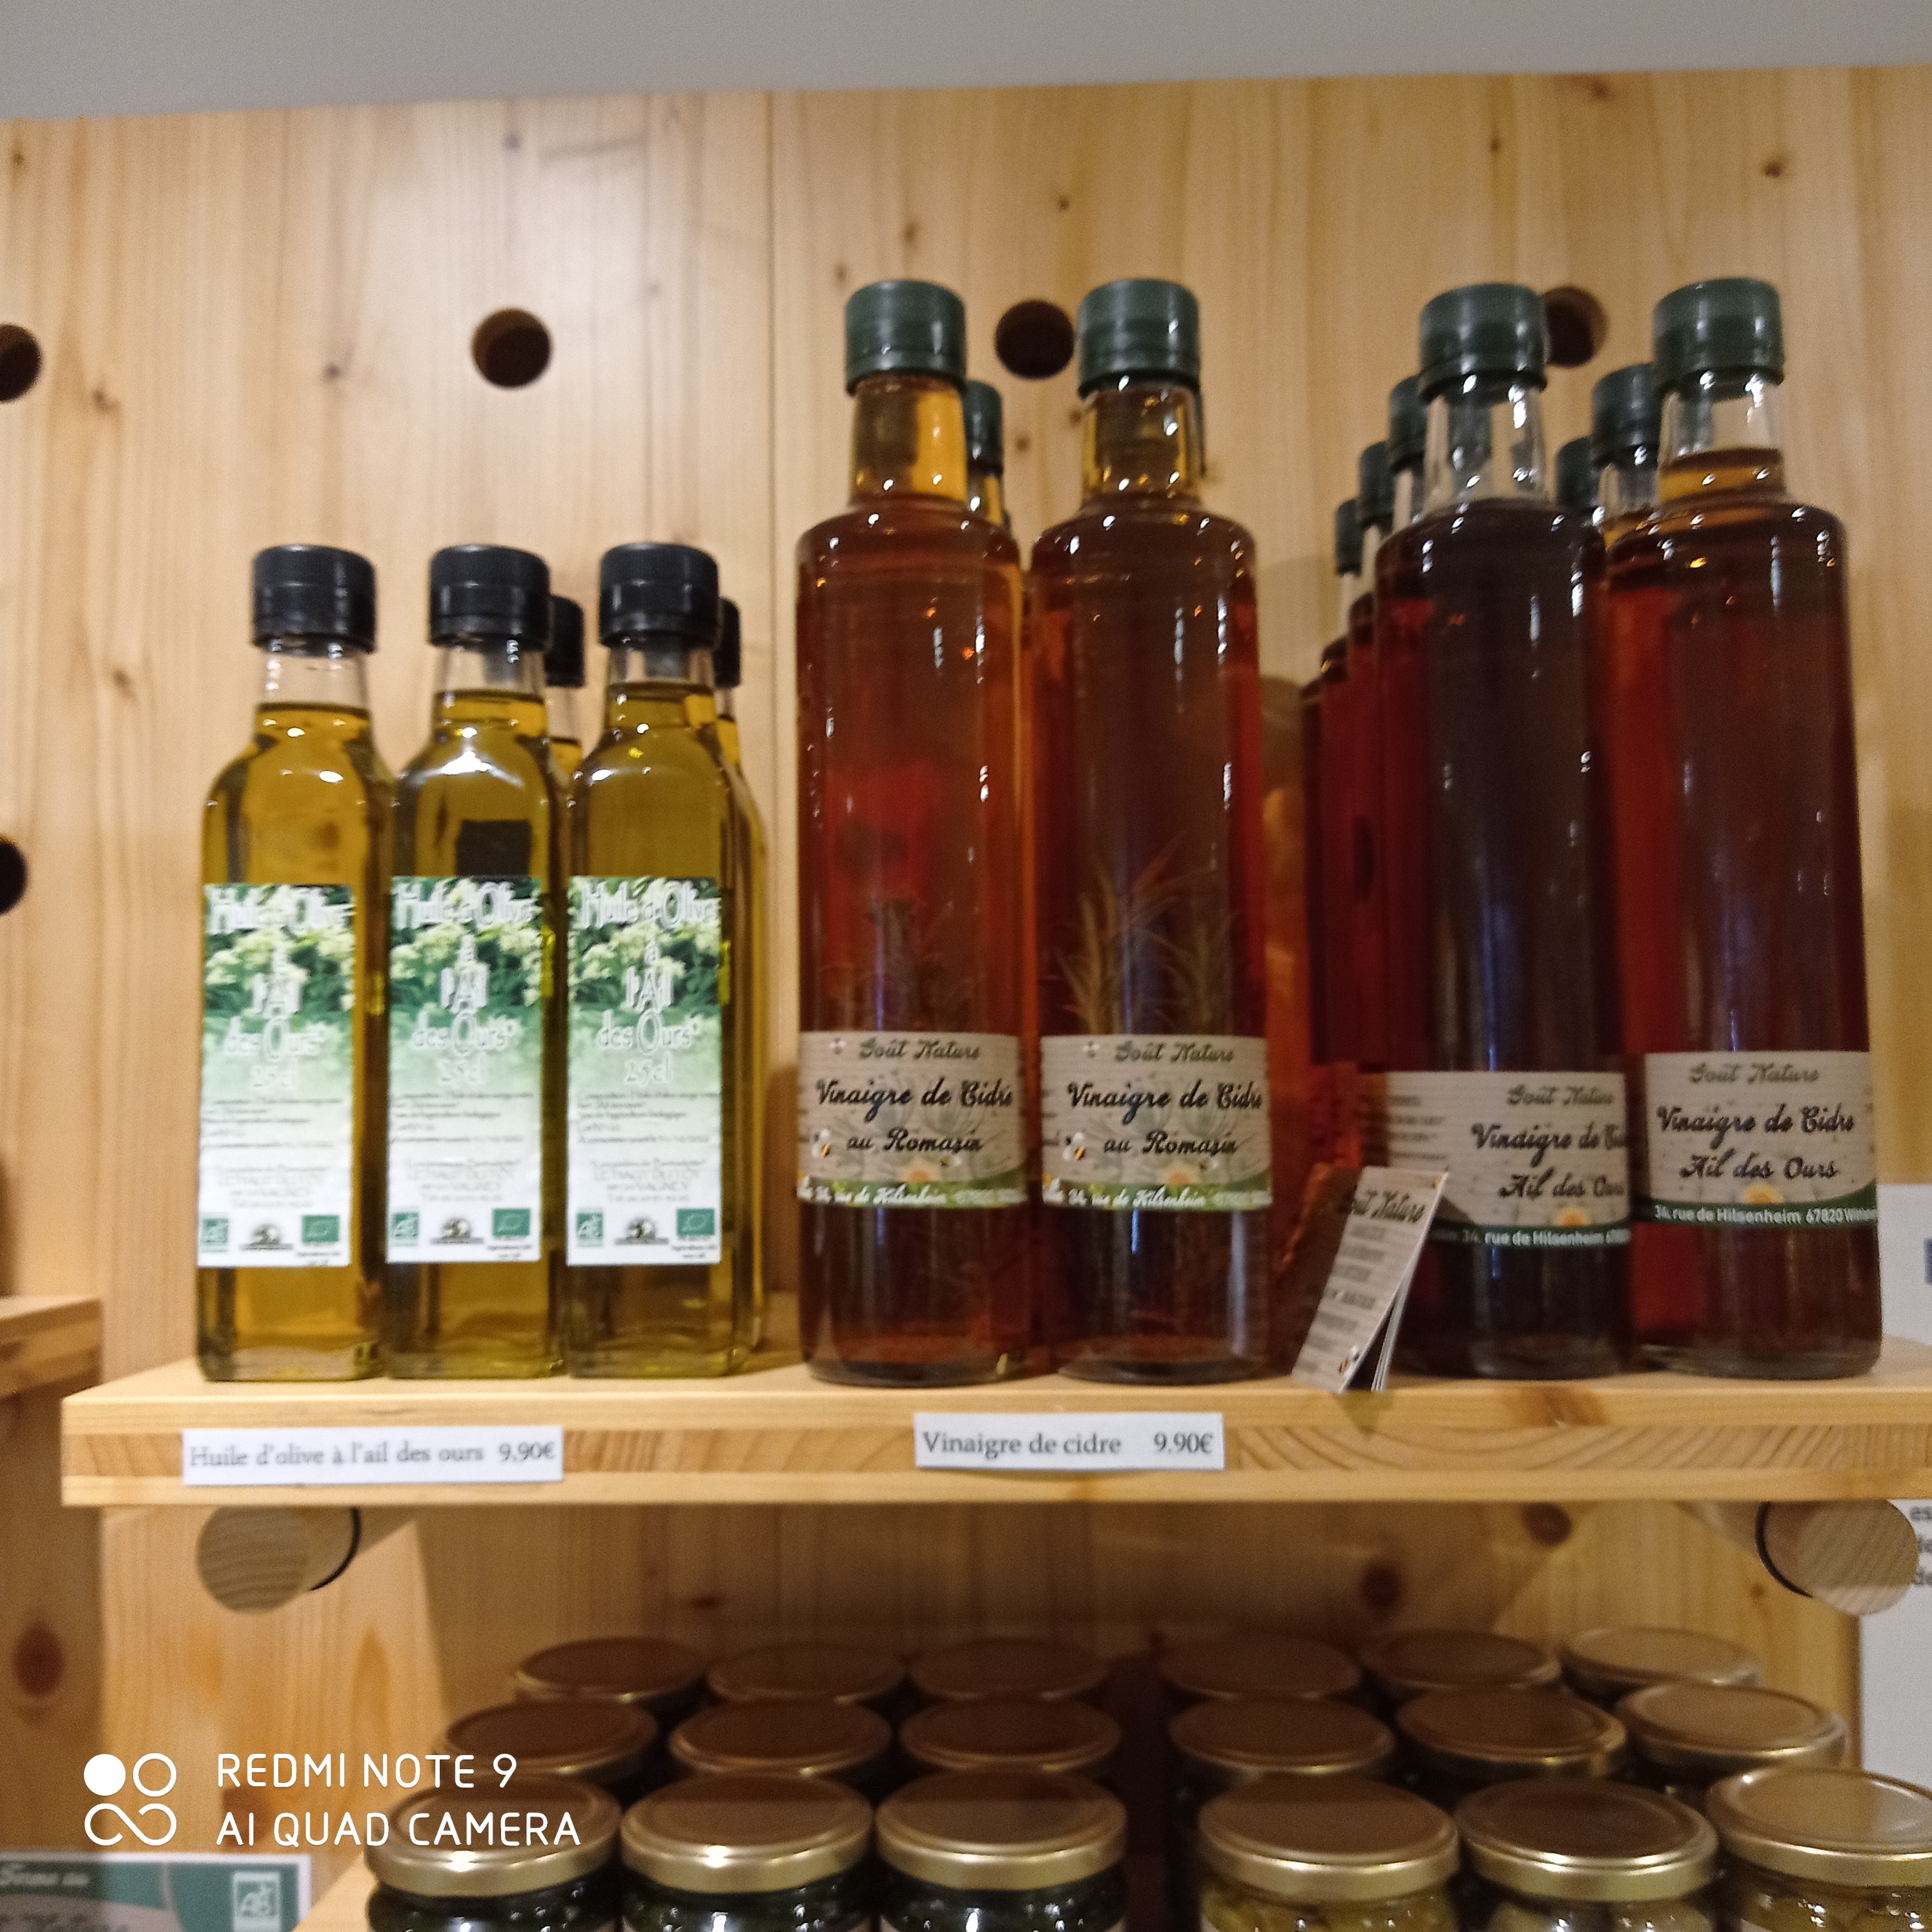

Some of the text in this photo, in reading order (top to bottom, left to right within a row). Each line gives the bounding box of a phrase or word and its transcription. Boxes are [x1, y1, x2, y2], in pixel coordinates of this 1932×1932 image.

[913, 1039, 980, 1060] Nature
[1171, 1042, 1235, 1062] Nature
[1747, 1063, 1820, 1084] Nature
[816, 1077, 912, 1124] Vinaigre
[920, 1076, 952, 1105] de
[1067, 1080, 1171, 1125] Vinaigre
[1179, 1078, 1208, 1108] de
[1656, 1105, 1756, 1150] Vinaigre
[1764, 1103, 1794, 1133] de
[847, 1136, 873, 1151] au
[1104, 1138, 1132, 1154] au
[1471, 1122, 1572, 1167] Vinaigre
[1578, 1121, 1599, 1149] de
[1680, 1147, 1839, 1180] Ail des Ours
[1499, 1166, 1554, 1199] Ail
[1553, 1172, 1585, 1198] des
[1672, 1208, 1696, 1222] rue
[1696, 1206, 1716, 1223] de
[1485, 1231, 1512, 1246] rue
[1512, 1229, 1532, 1246] de
[190, 1440, 557, 1467] Huile d'olive à l'ail des ours 9.90€
[923, 1431, 1214, 1460] Vinaigre de cidre 9.90€
